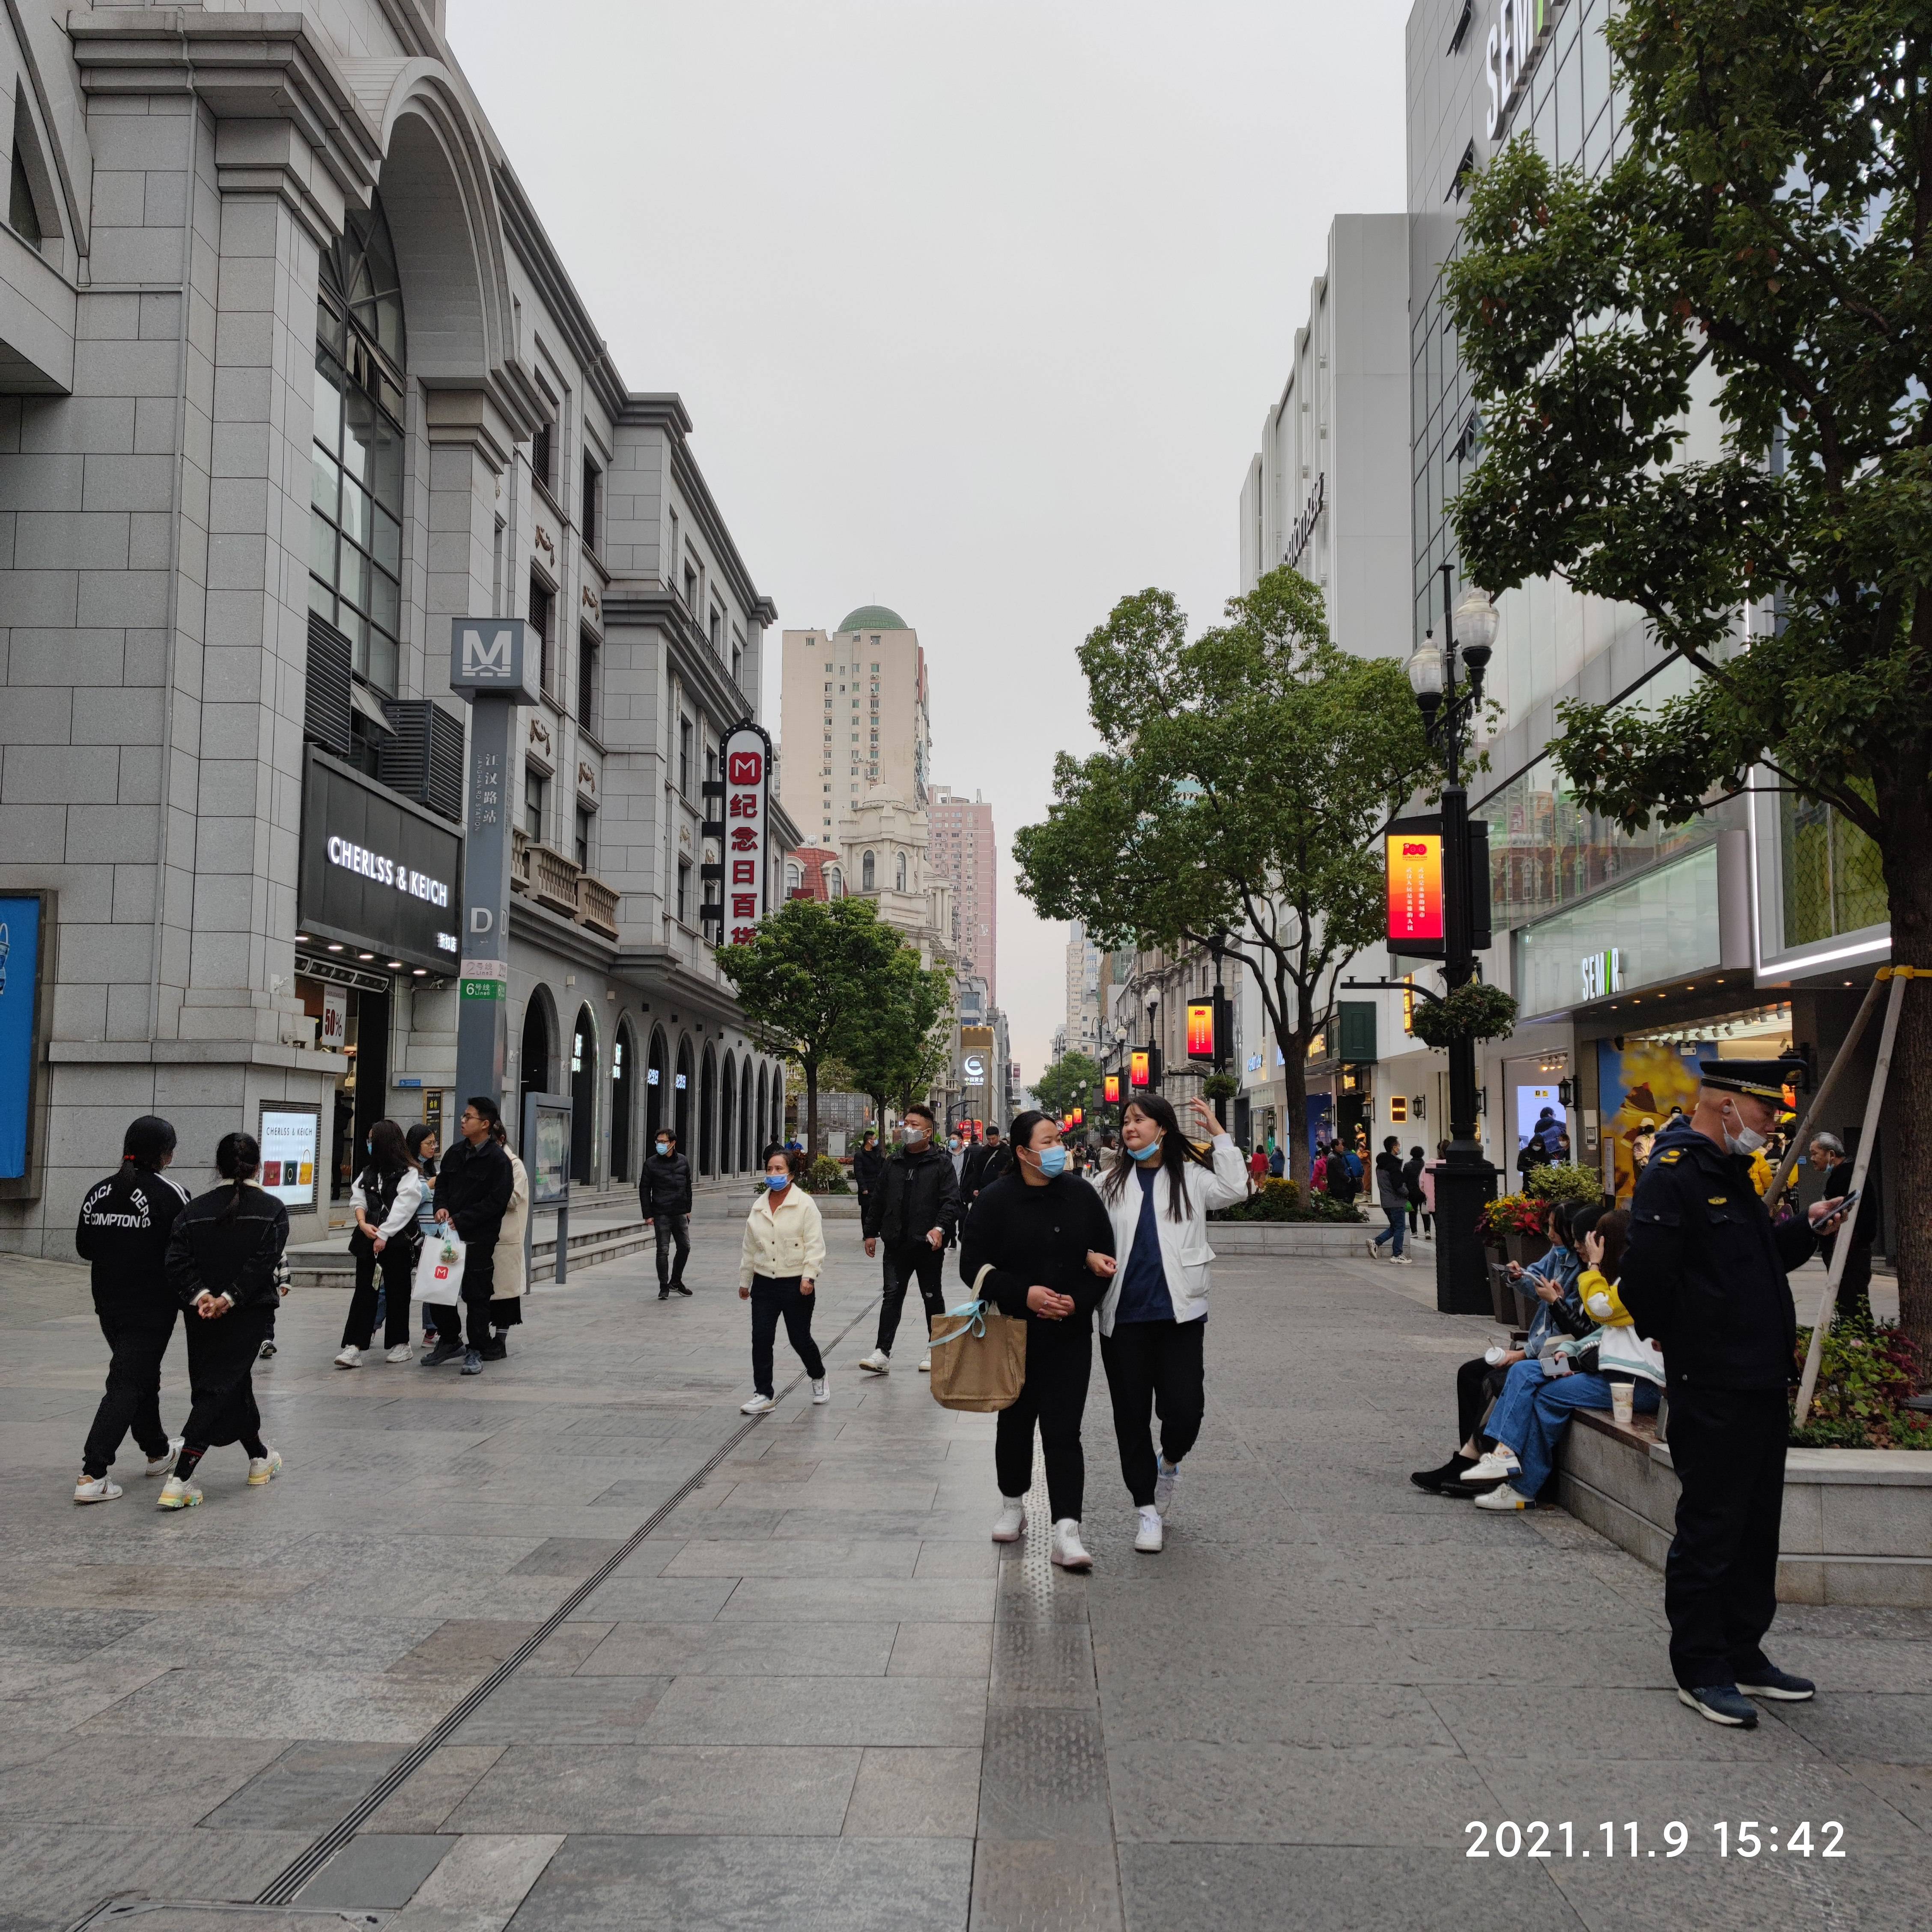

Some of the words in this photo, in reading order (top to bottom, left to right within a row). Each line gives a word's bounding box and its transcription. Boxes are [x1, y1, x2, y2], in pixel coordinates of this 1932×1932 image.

[1486, 0, 1554, 140] SEM
[476, 790, 482, 799] RD
[483, 753, 500, 823] 江汉路站
[328, 836, 393, 885] CHERLSS
[396, 866, 407, 891] &
[409, 871, 448, 907] KEICH
[470, 907, 493, 933] D
[501, 909, 507, 935] D
[466, 962, 492, 975] 2号线
[1583, 947, 1620, 1001] SEMIR
[466, 983, 490, 995] 6号线
[325, 1008, 342, 1037] 50%
[266, 1127, 289, 1136] CHERLSS
[297, 1127, 312, 1136] KEICH
[91, 1213, 140, 1228] COMPTON
[437, 1268, 446, 1277] M
